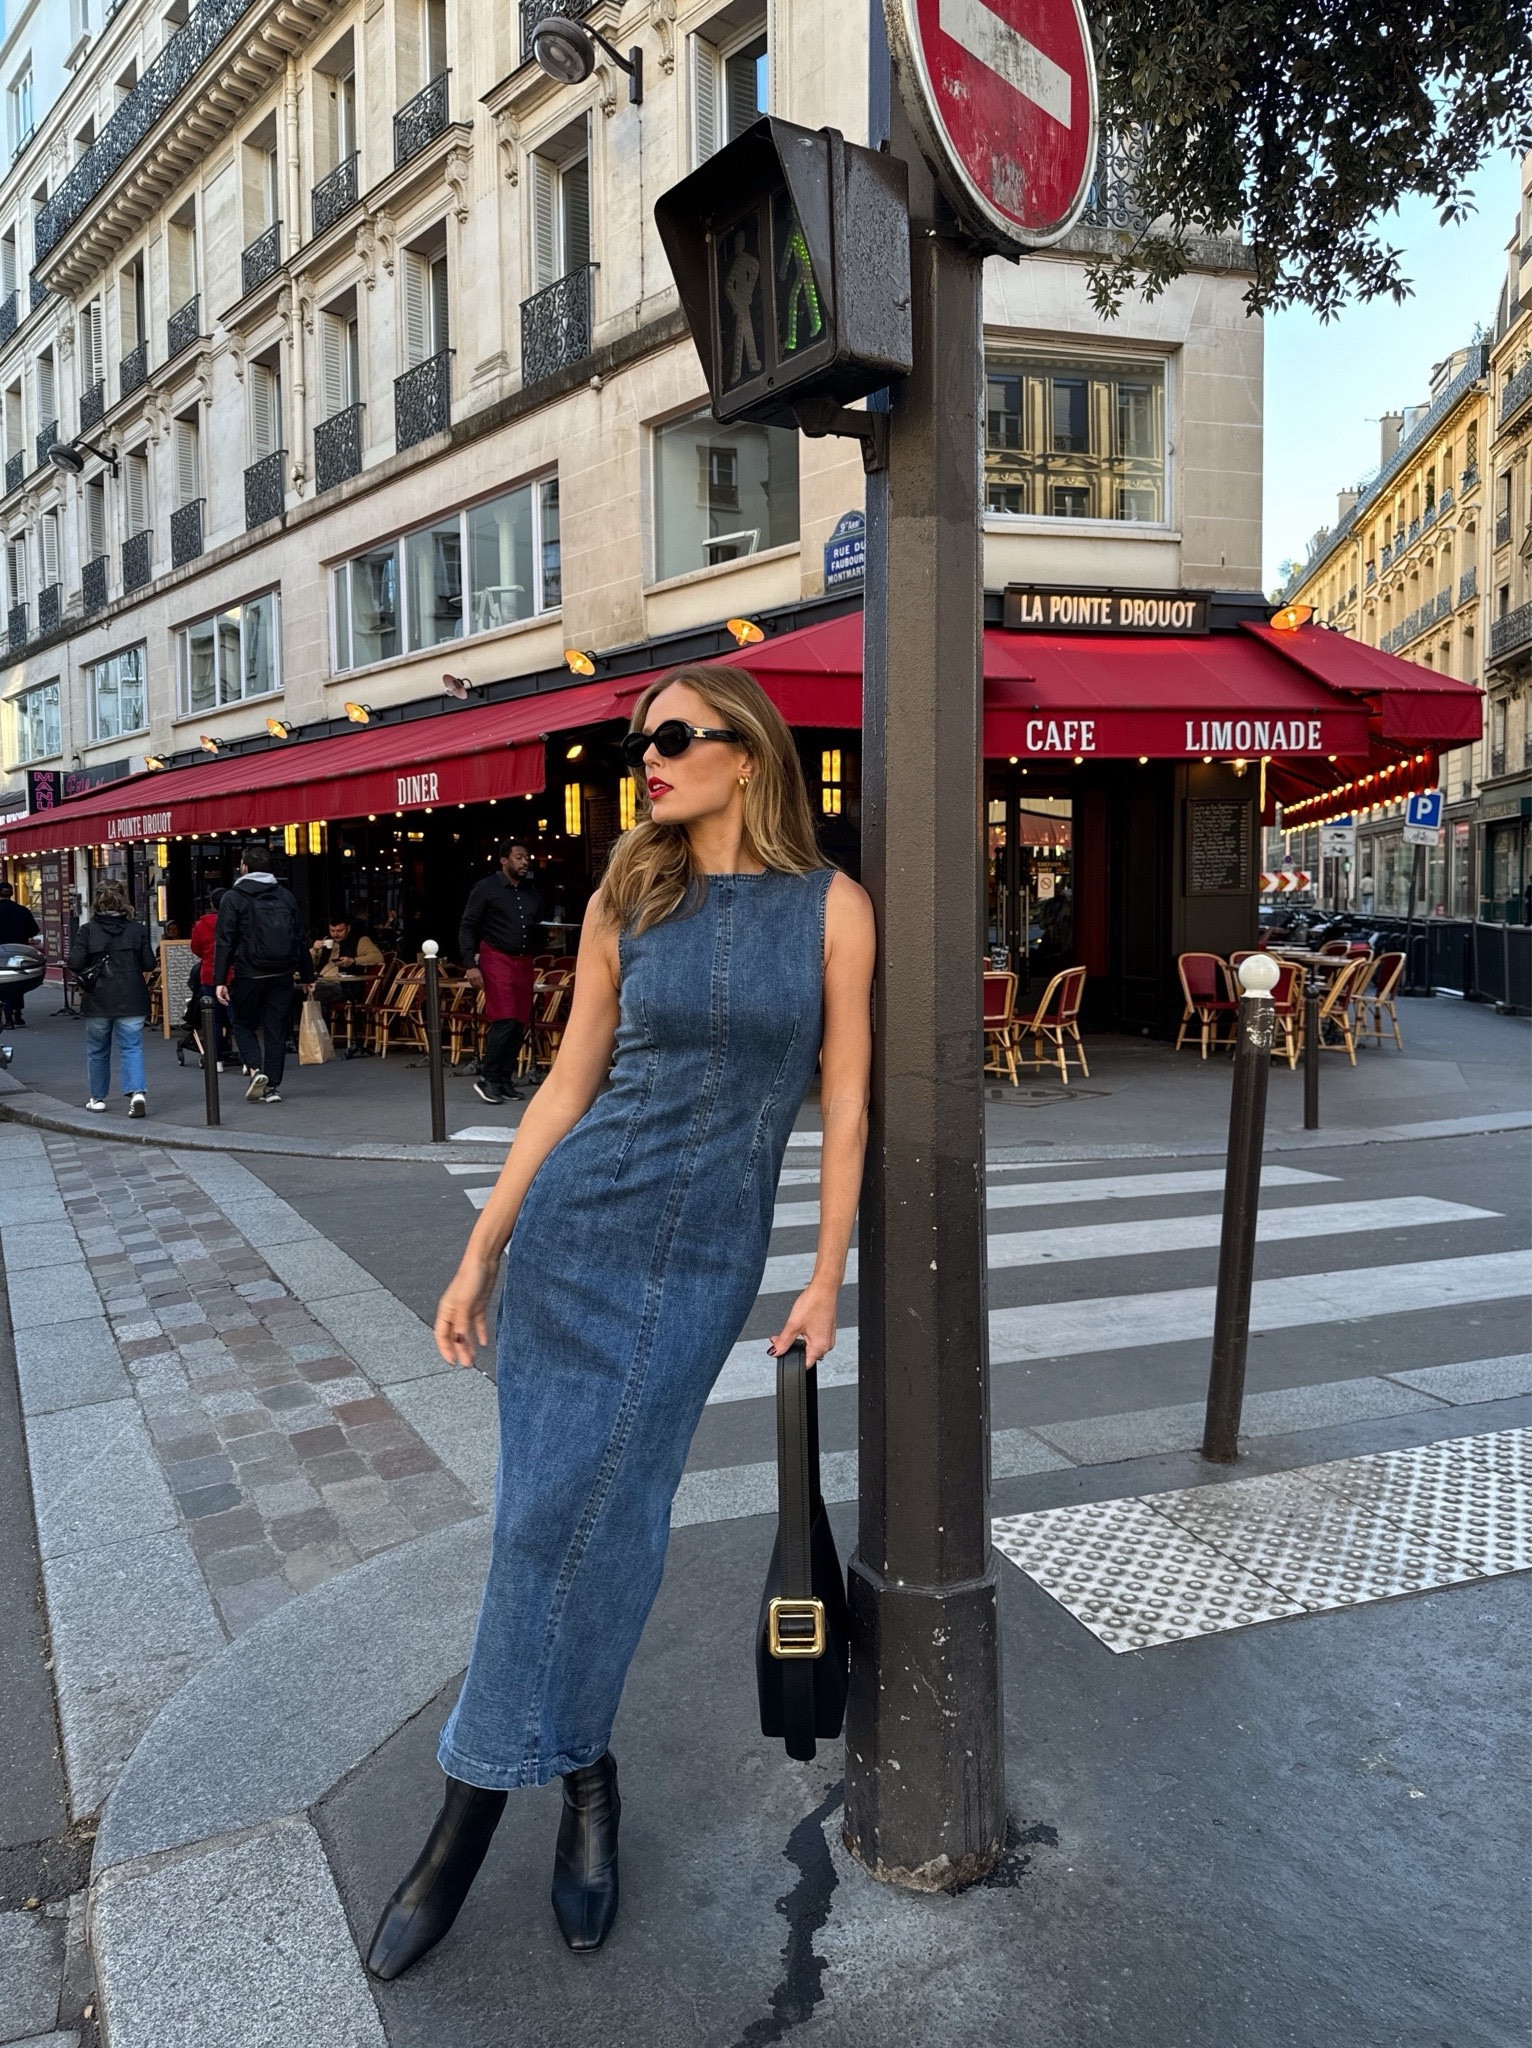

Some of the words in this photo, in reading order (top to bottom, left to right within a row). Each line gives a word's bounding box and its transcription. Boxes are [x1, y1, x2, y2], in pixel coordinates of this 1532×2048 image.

[833, 544, 850, 558] RUE
[854, 542, 865, 553] DU
[828, 566, 865, 584] MONTMART
[831, 555, 865, 571] FAUBOUR
[1021, 594, 1043, 623] LA
[1049, 596, 1112, 625] POINTE
[1119, 598, 1196, 628] DROUOT
[1026, 720, 1096, 751] CAFE
[1185, 720, 1322, 751] LIMONADE
[397, 772, 439, 806] DINER
[1416, 797, 1433, 820] P
[108, 820, 117, 839] LA
[117, 816, 142, 838] POINTE
[142, 812, 172, 835] DROUOT
